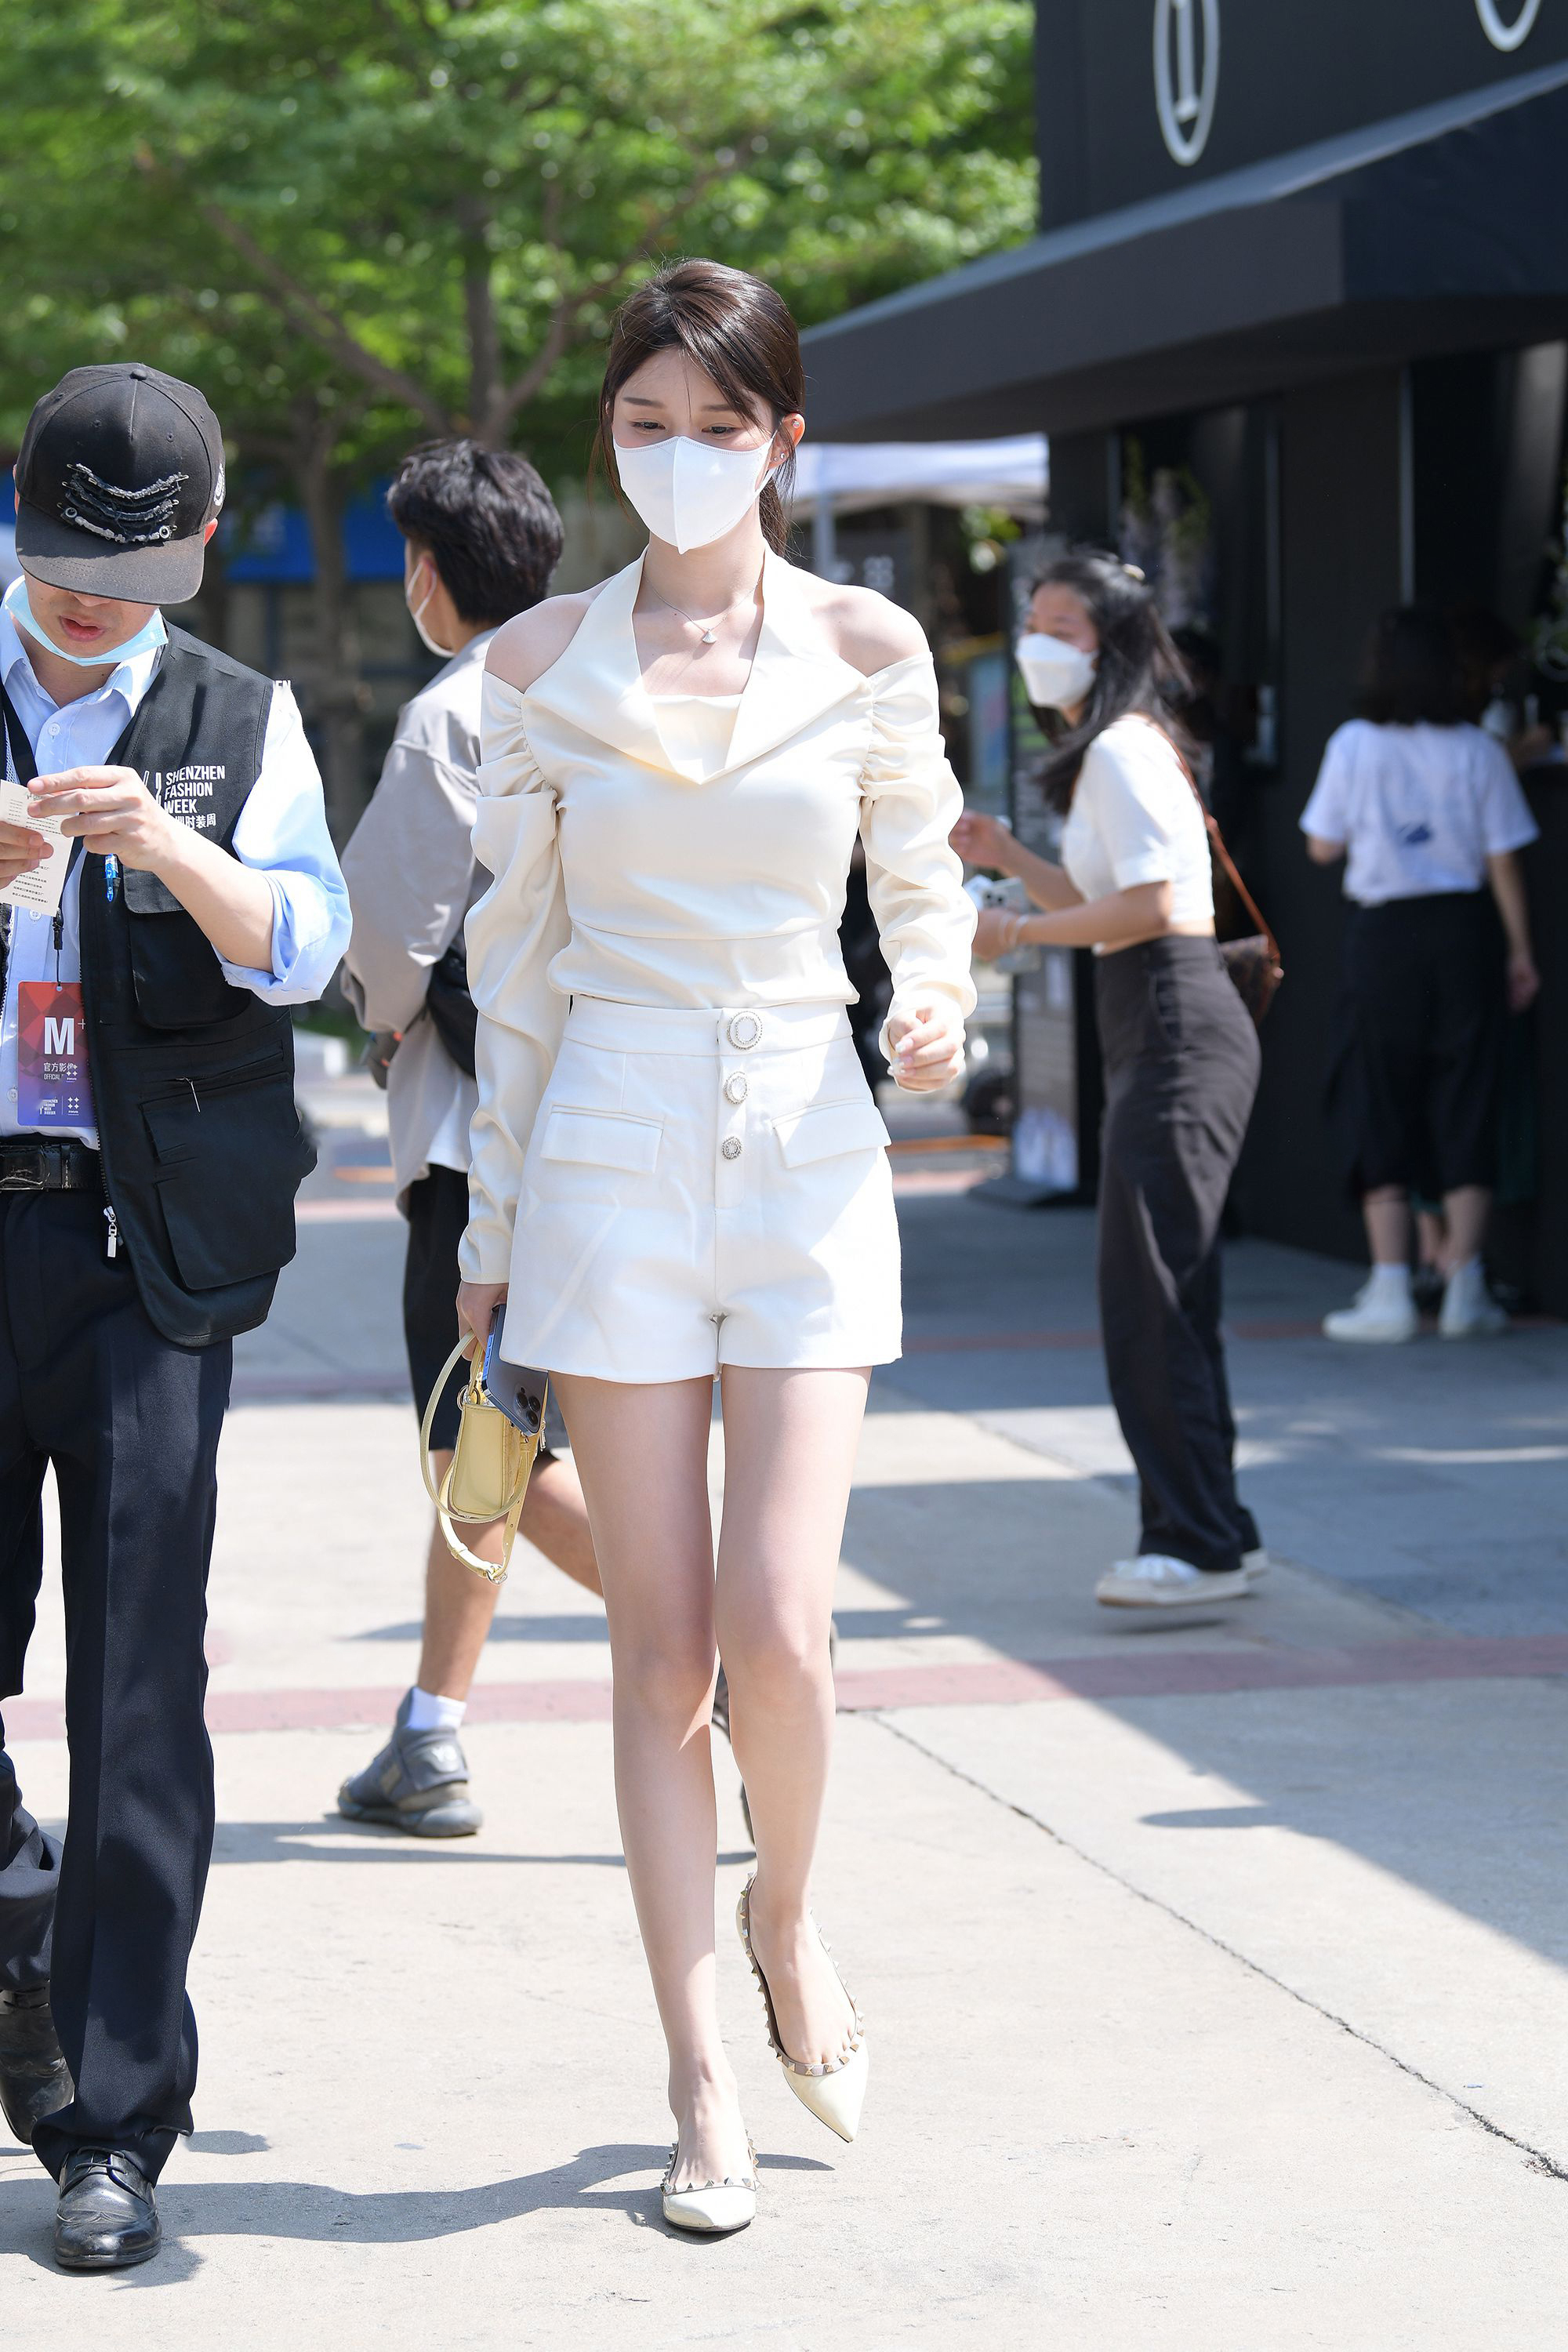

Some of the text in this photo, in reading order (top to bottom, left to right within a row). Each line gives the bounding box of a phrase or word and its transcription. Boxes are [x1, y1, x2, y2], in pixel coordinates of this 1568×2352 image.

[165, 765, 226, 786] SHENZHEN
[165, 782, 212, 800] FASHION
[164, 799, 198, 814] WEEK
[45, 1018, 74, 1054] M
